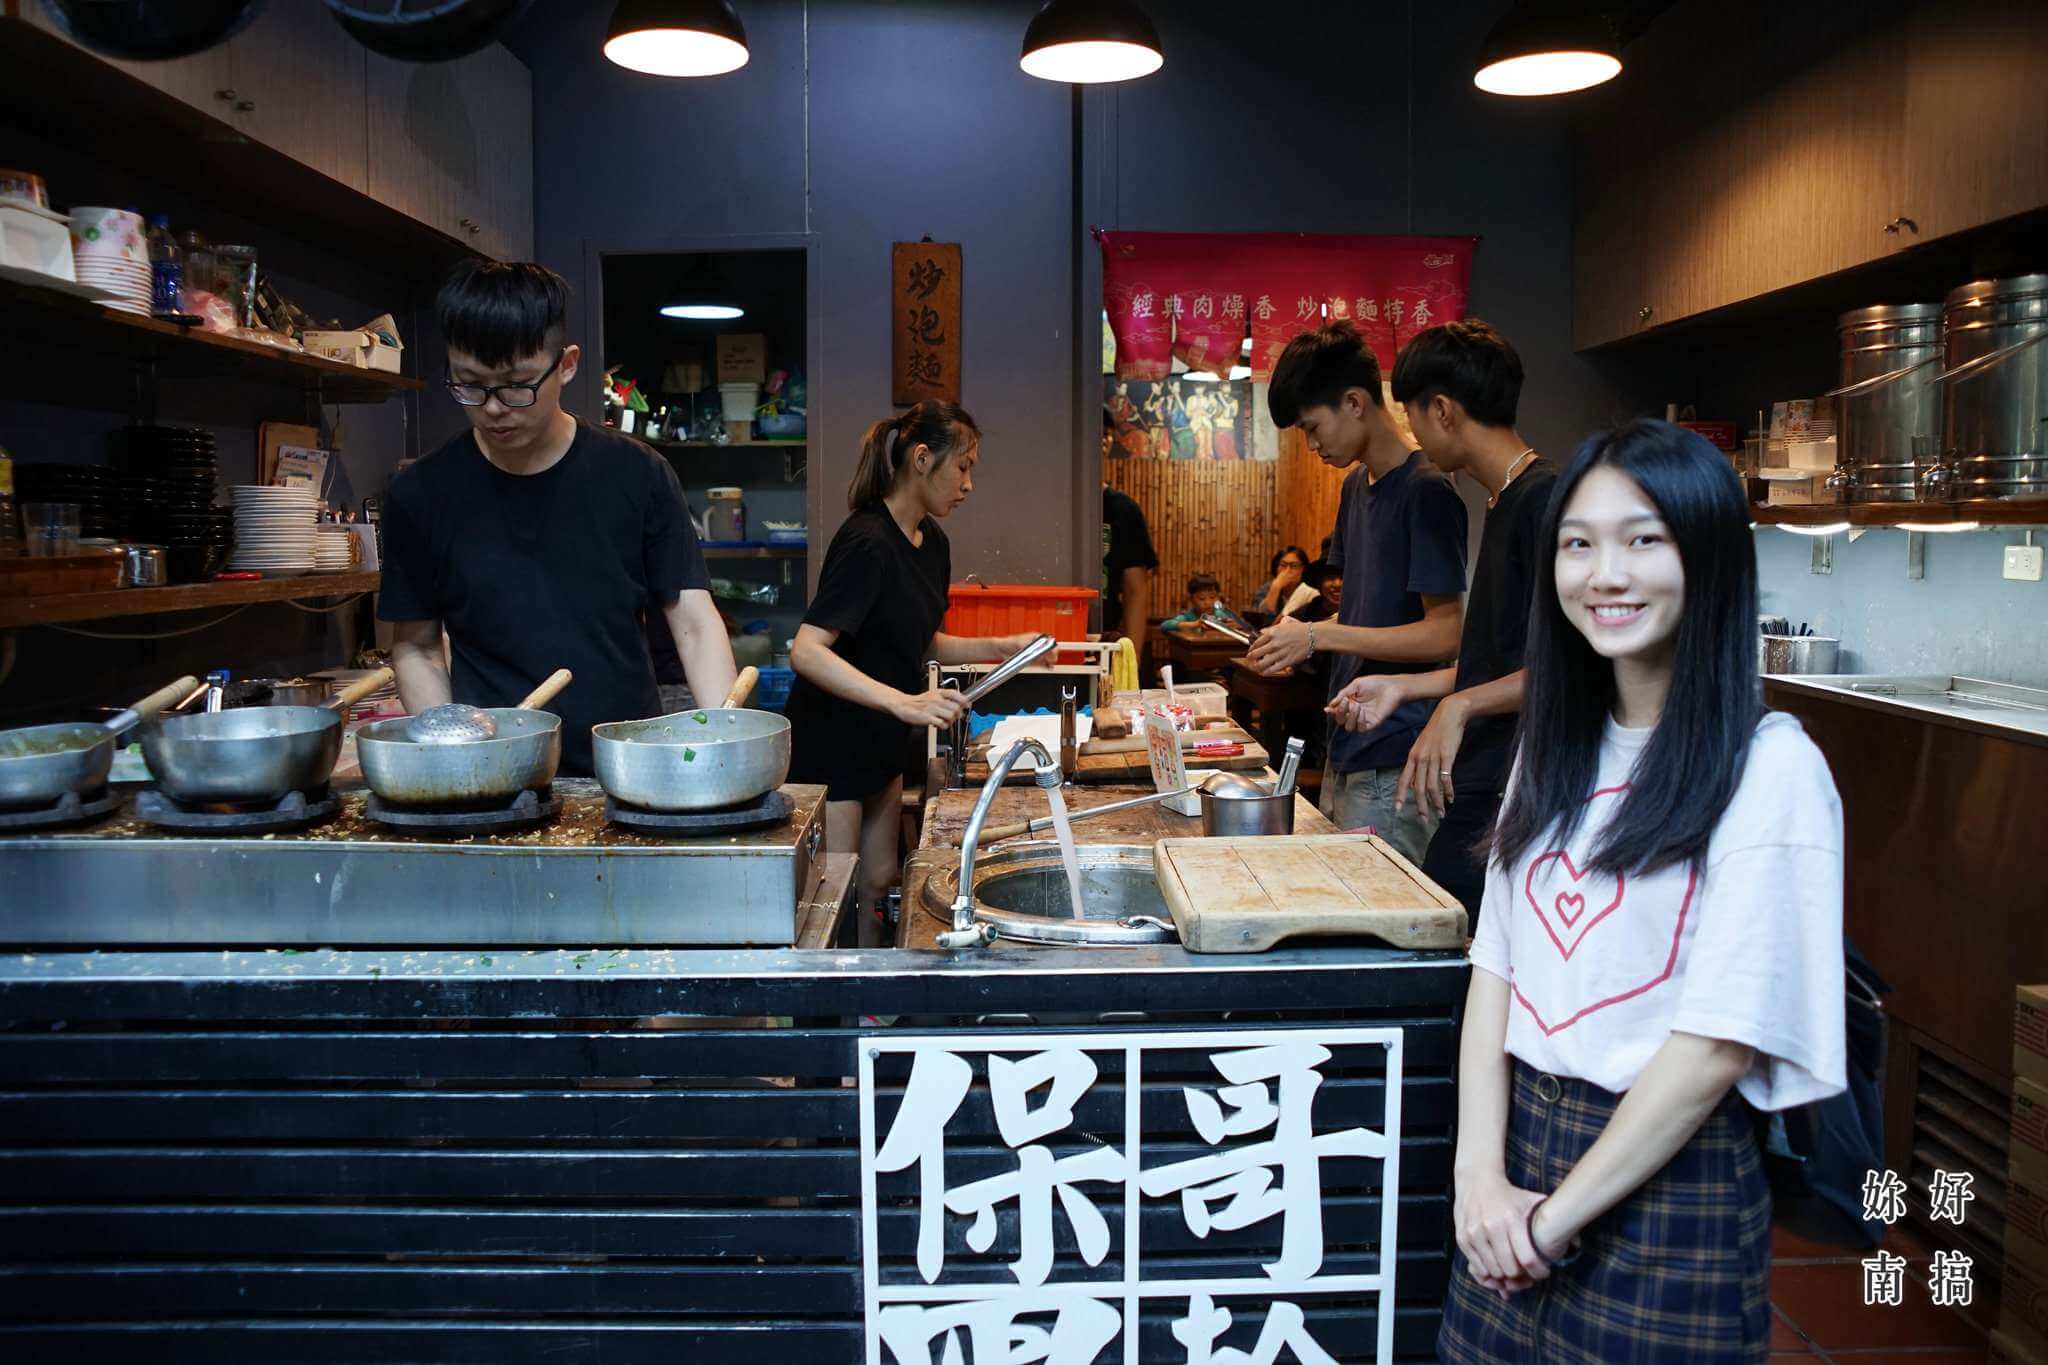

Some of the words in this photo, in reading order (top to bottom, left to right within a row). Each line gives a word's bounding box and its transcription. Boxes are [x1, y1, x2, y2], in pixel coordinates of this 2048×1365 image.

[907, 258, 946, 387] 炒泡麵
[1132, 293, 1277, 320] 經典肉燥香
[1296, 295, 1434, 326] 炒泡麵特香
[874, 1043, 1386, 1285] 保哥
